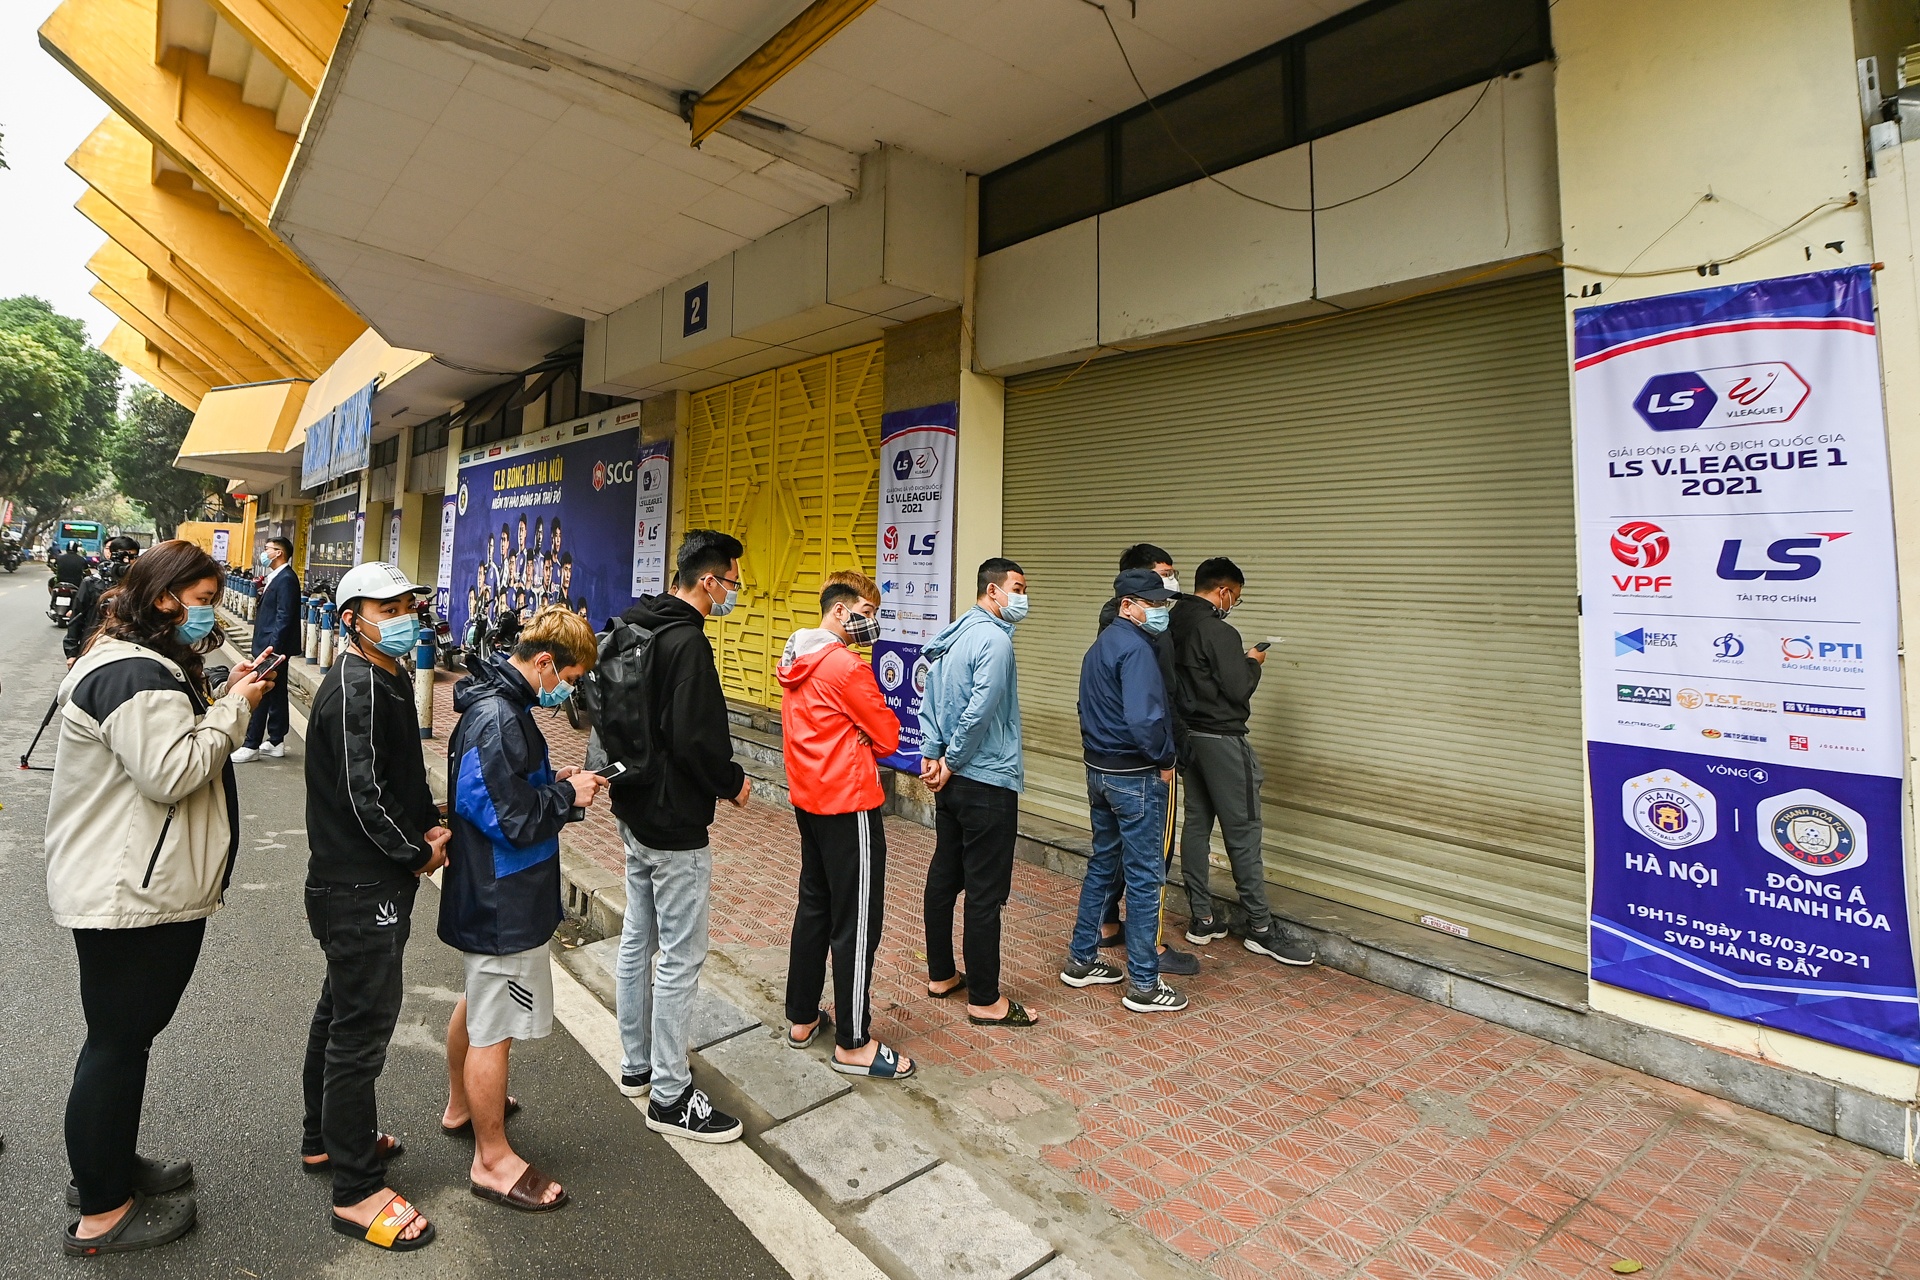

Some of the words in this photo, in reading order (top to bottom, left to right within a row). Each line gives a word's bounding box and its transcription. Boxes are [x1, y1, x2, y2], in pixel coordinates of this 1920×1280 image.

[690, 296, 701, 325] 2
[1647, 390, 1695, 414] LS
[1727, 406, 1777, 418] V.LEAGUE
[1779, 406, 1784, 414] 1
[1608, 446, 1633, 458] GIẢI
[1637, 445, 1676, 456] BÓNG
[1680, 442, 1701, 453] ĐÁ
[1730, 440, 1763, 451] ĐỊCH
[1769, 434, 1814, 447] QUỐC
[1818, 433, 1846, 443] GIA
[896, 460, 909, 471] LS
[1609, 460, 1644, 478] LS
[1651, 449, 1818, 476] V.LEAGUE
[1827, 448, 1848, 466] 1
[493, 469, 506, 491] CLB
[506, 463, 526, 489] BÓNG
[526, 458, 536, 486] ĐÁ
[537, 456, 547, 485] HÀ
[549, 454, 563, 486] NỘI
[606, 460, 633, 485] SCG
[1682, 476, 1762, 496] 2021
[886, 494, 894, 504] LS
[895, 491, 940, 503] V.LEAGUE
[901, 503, 923, 514] 2021
[648, 525, 658, 540] LS
[908, 534, 936, 556] LS
[1716, 538, 1822, 581] LS
[1611, 575, 1672, 592] VPF
[1736, 593, 1753, 601] TÀI
[1755, 594, 1778, 603] TRỢ
[1781, 593, 1817, 603] CHÍNH
[1645, 632, 1678, 641] NEXT
[1645, 639, 1678, 648] MEDIA
[1819, 642, 1862, 660] PTI
[1823, 665, 1841, 673] BƯU
[1634, 687, 1670, 700] AAN
[1705, 693, 1742, 704] T&T
[1740, 700, 1776, 709] GROUP
[888, 696, 902, 709] NỘI
[1796, 703, 1861, 717] Vinawind
[1618, 719, 1661, 728] BAMBOO
[1706, 764, 1748, 778] VÒNG
[1753, 771, 1765, 780] 4
[1645, 792, 1691, 808] HANOI
[1780, 809, 1810, 823] THANH
[1812, 810, 1833, 823] HÓA
[1832, 821, 1846, 833] FC
[1625, 852, 1663, 876] HÀ
[1669, 860, 1718, 888] NỘI
[1765, 872, 1842, 900] ĐÔNG
[1847, 885, 1866, 905] Á
[1744, 888, 1828, 919] THANH
[1835, 906, 1891, 932] HÓA
[1627, 903, 1688, 926] 19H15
[1692, 922, 1742, 941] ngày
[1747, 930, 1870, 969] 18/03/2021
[1664, 930, 1705, 949] SVĐ
[1709, 941, 1772, 967] HÀNG
[1776, 956, 1823, 978] ĐẪY
